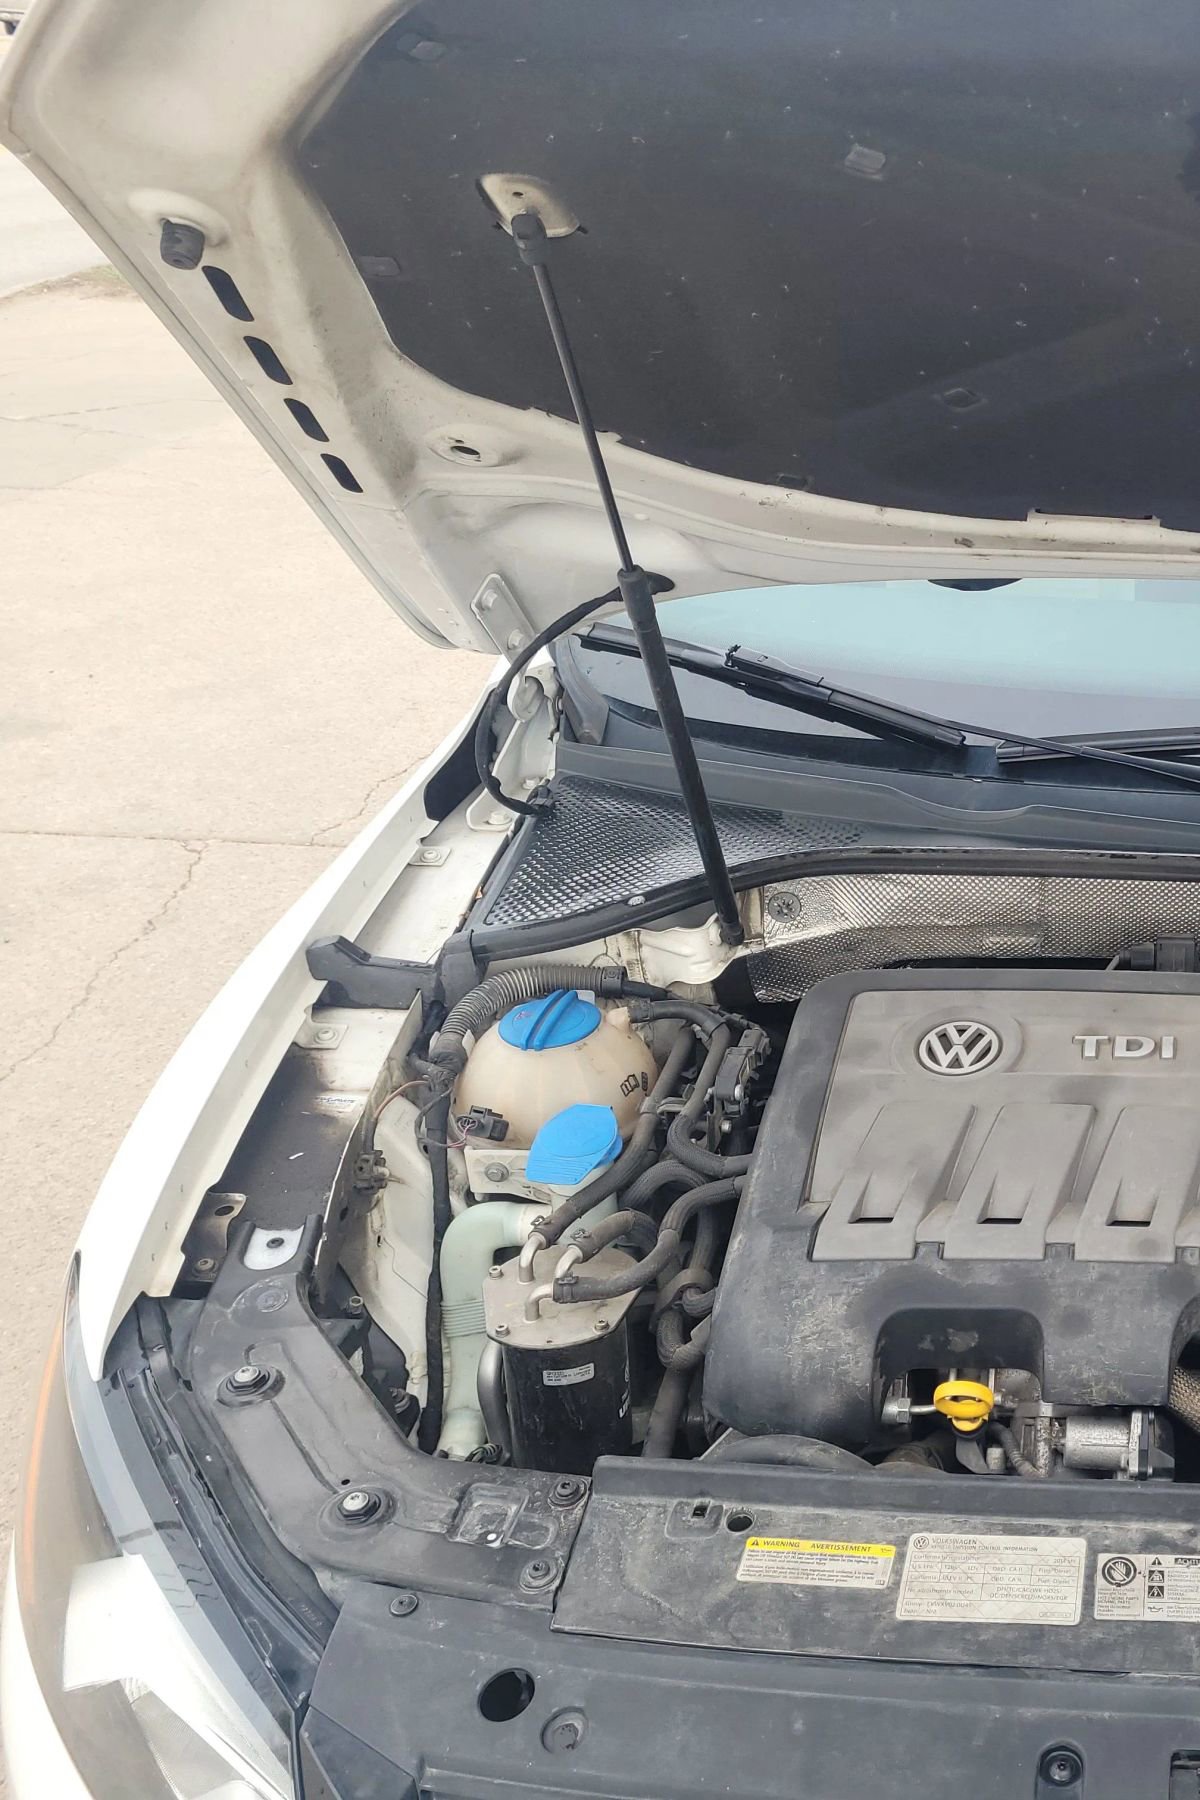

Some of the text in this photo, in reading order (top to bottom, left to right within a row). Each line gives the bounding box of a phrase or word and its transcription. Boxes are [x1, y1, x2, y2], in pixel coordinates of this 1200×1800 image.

[1071, 1034, 1177, 1060] TDI
[763, 1540, 872, 1553] WARNING AVERTISSEMENT
